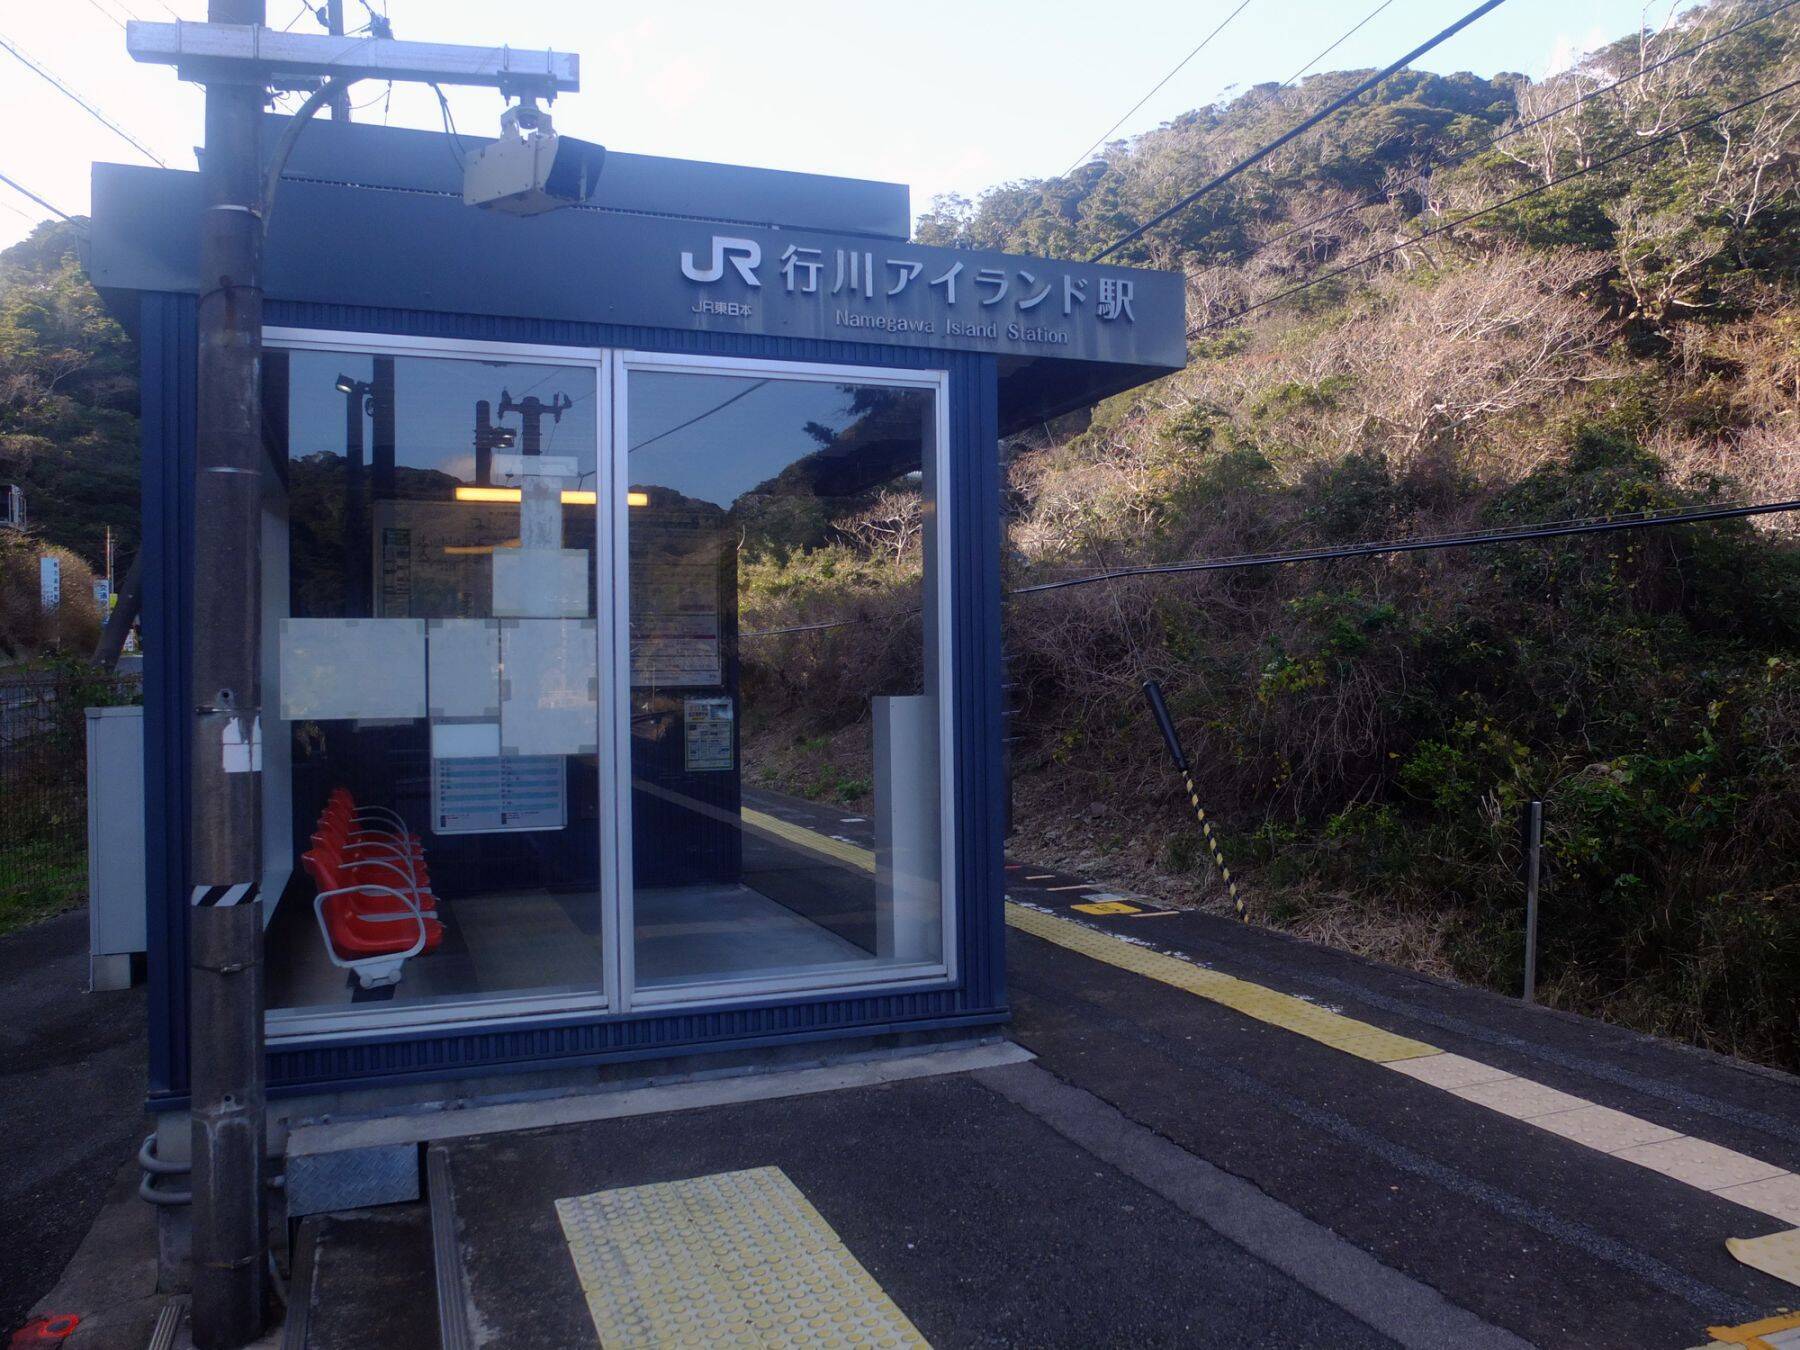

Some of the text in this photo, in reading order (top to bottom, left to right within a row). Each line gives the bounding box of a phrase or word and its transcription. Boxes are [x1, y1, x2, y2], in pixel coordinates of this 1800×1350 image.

[681, 236, 762, 287] JR
[781, 246, 1135, 322] 行川アイランド駅
[691, 300, 753, 318] JR東日本
[836, 309, 1068, 345] Namegawa Island Station
